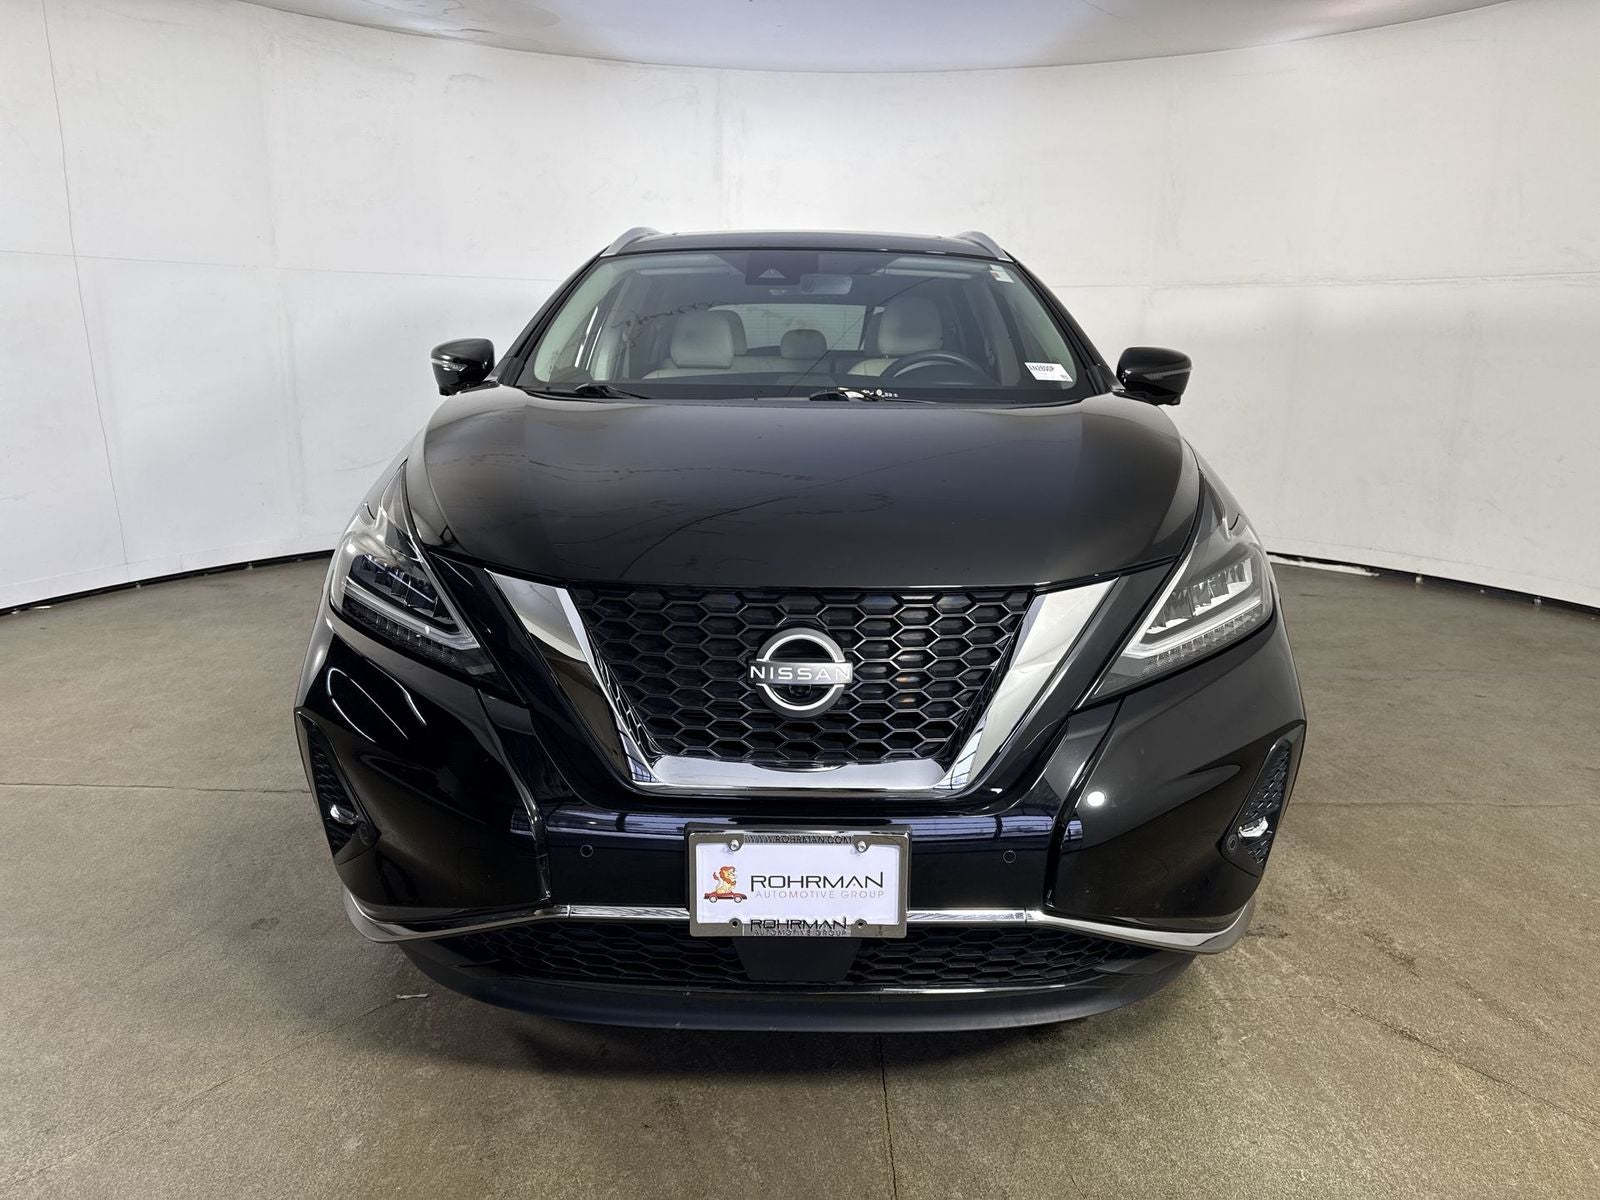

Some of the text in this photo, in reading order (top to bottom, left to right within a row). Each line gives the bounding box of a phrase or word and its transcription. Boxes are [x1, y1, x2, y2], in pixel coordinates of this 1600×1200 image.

[750, 665, 850, 680] NISSAN
[750, 871, 884, 892] ROHRMAN
[755, 890, 884, 899] AUTOMOTIVE GROUP
[750, 916, 847, 932] ROHRMAN
